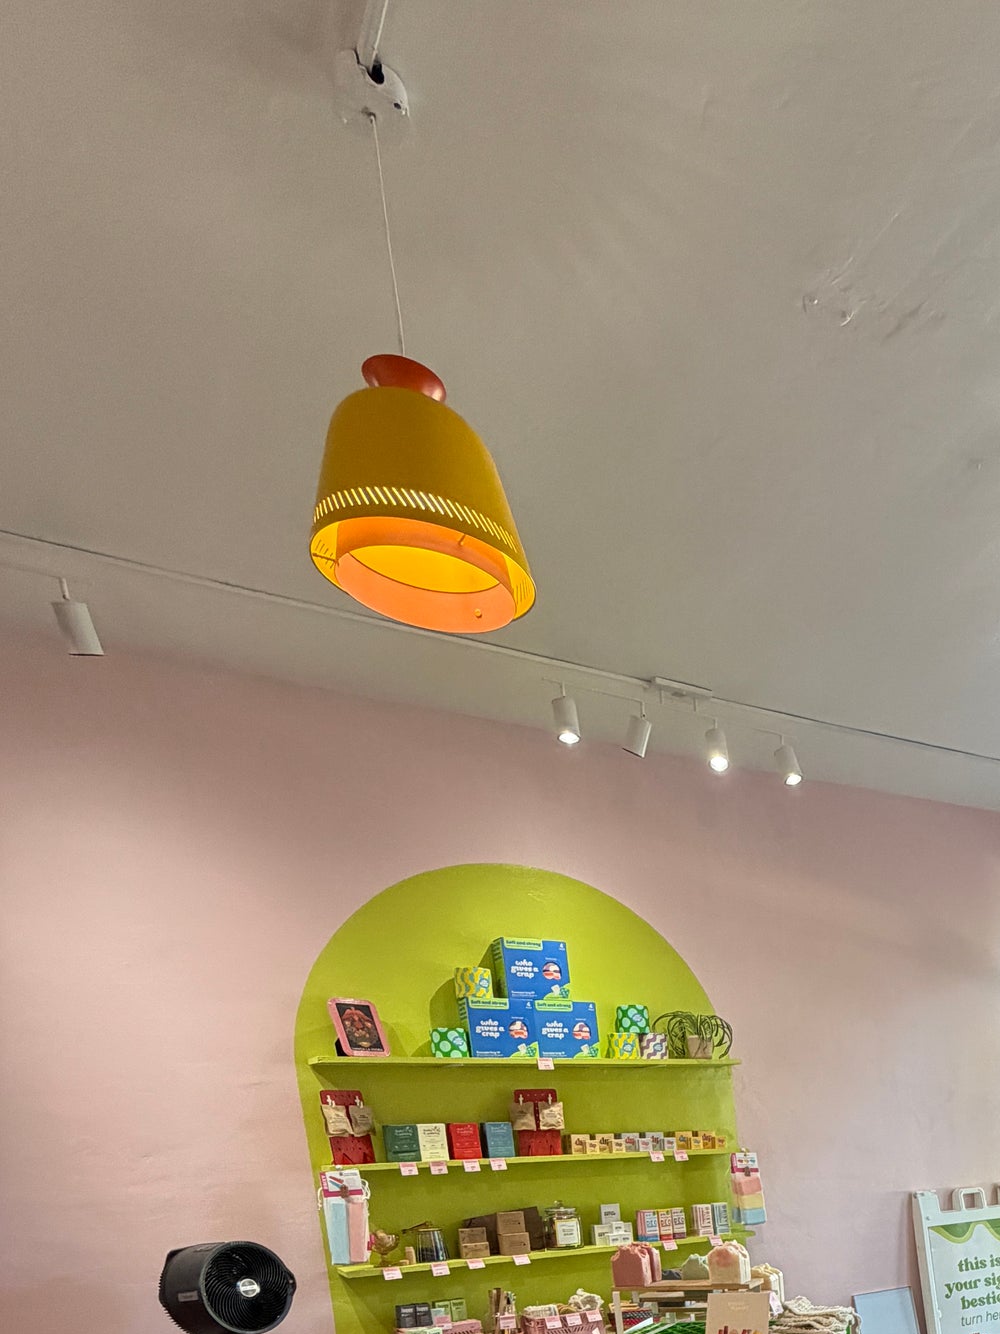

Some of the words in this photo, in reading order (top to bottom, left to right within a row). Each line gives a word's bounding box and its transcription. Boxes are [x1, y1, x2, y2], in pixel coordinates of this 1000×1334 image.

[515, 959, 533, 967] who
[958, 1257, 987, 1272] this
[945, 1279, 981, 1299] your
[961, 1316, 982, 1327] turn
